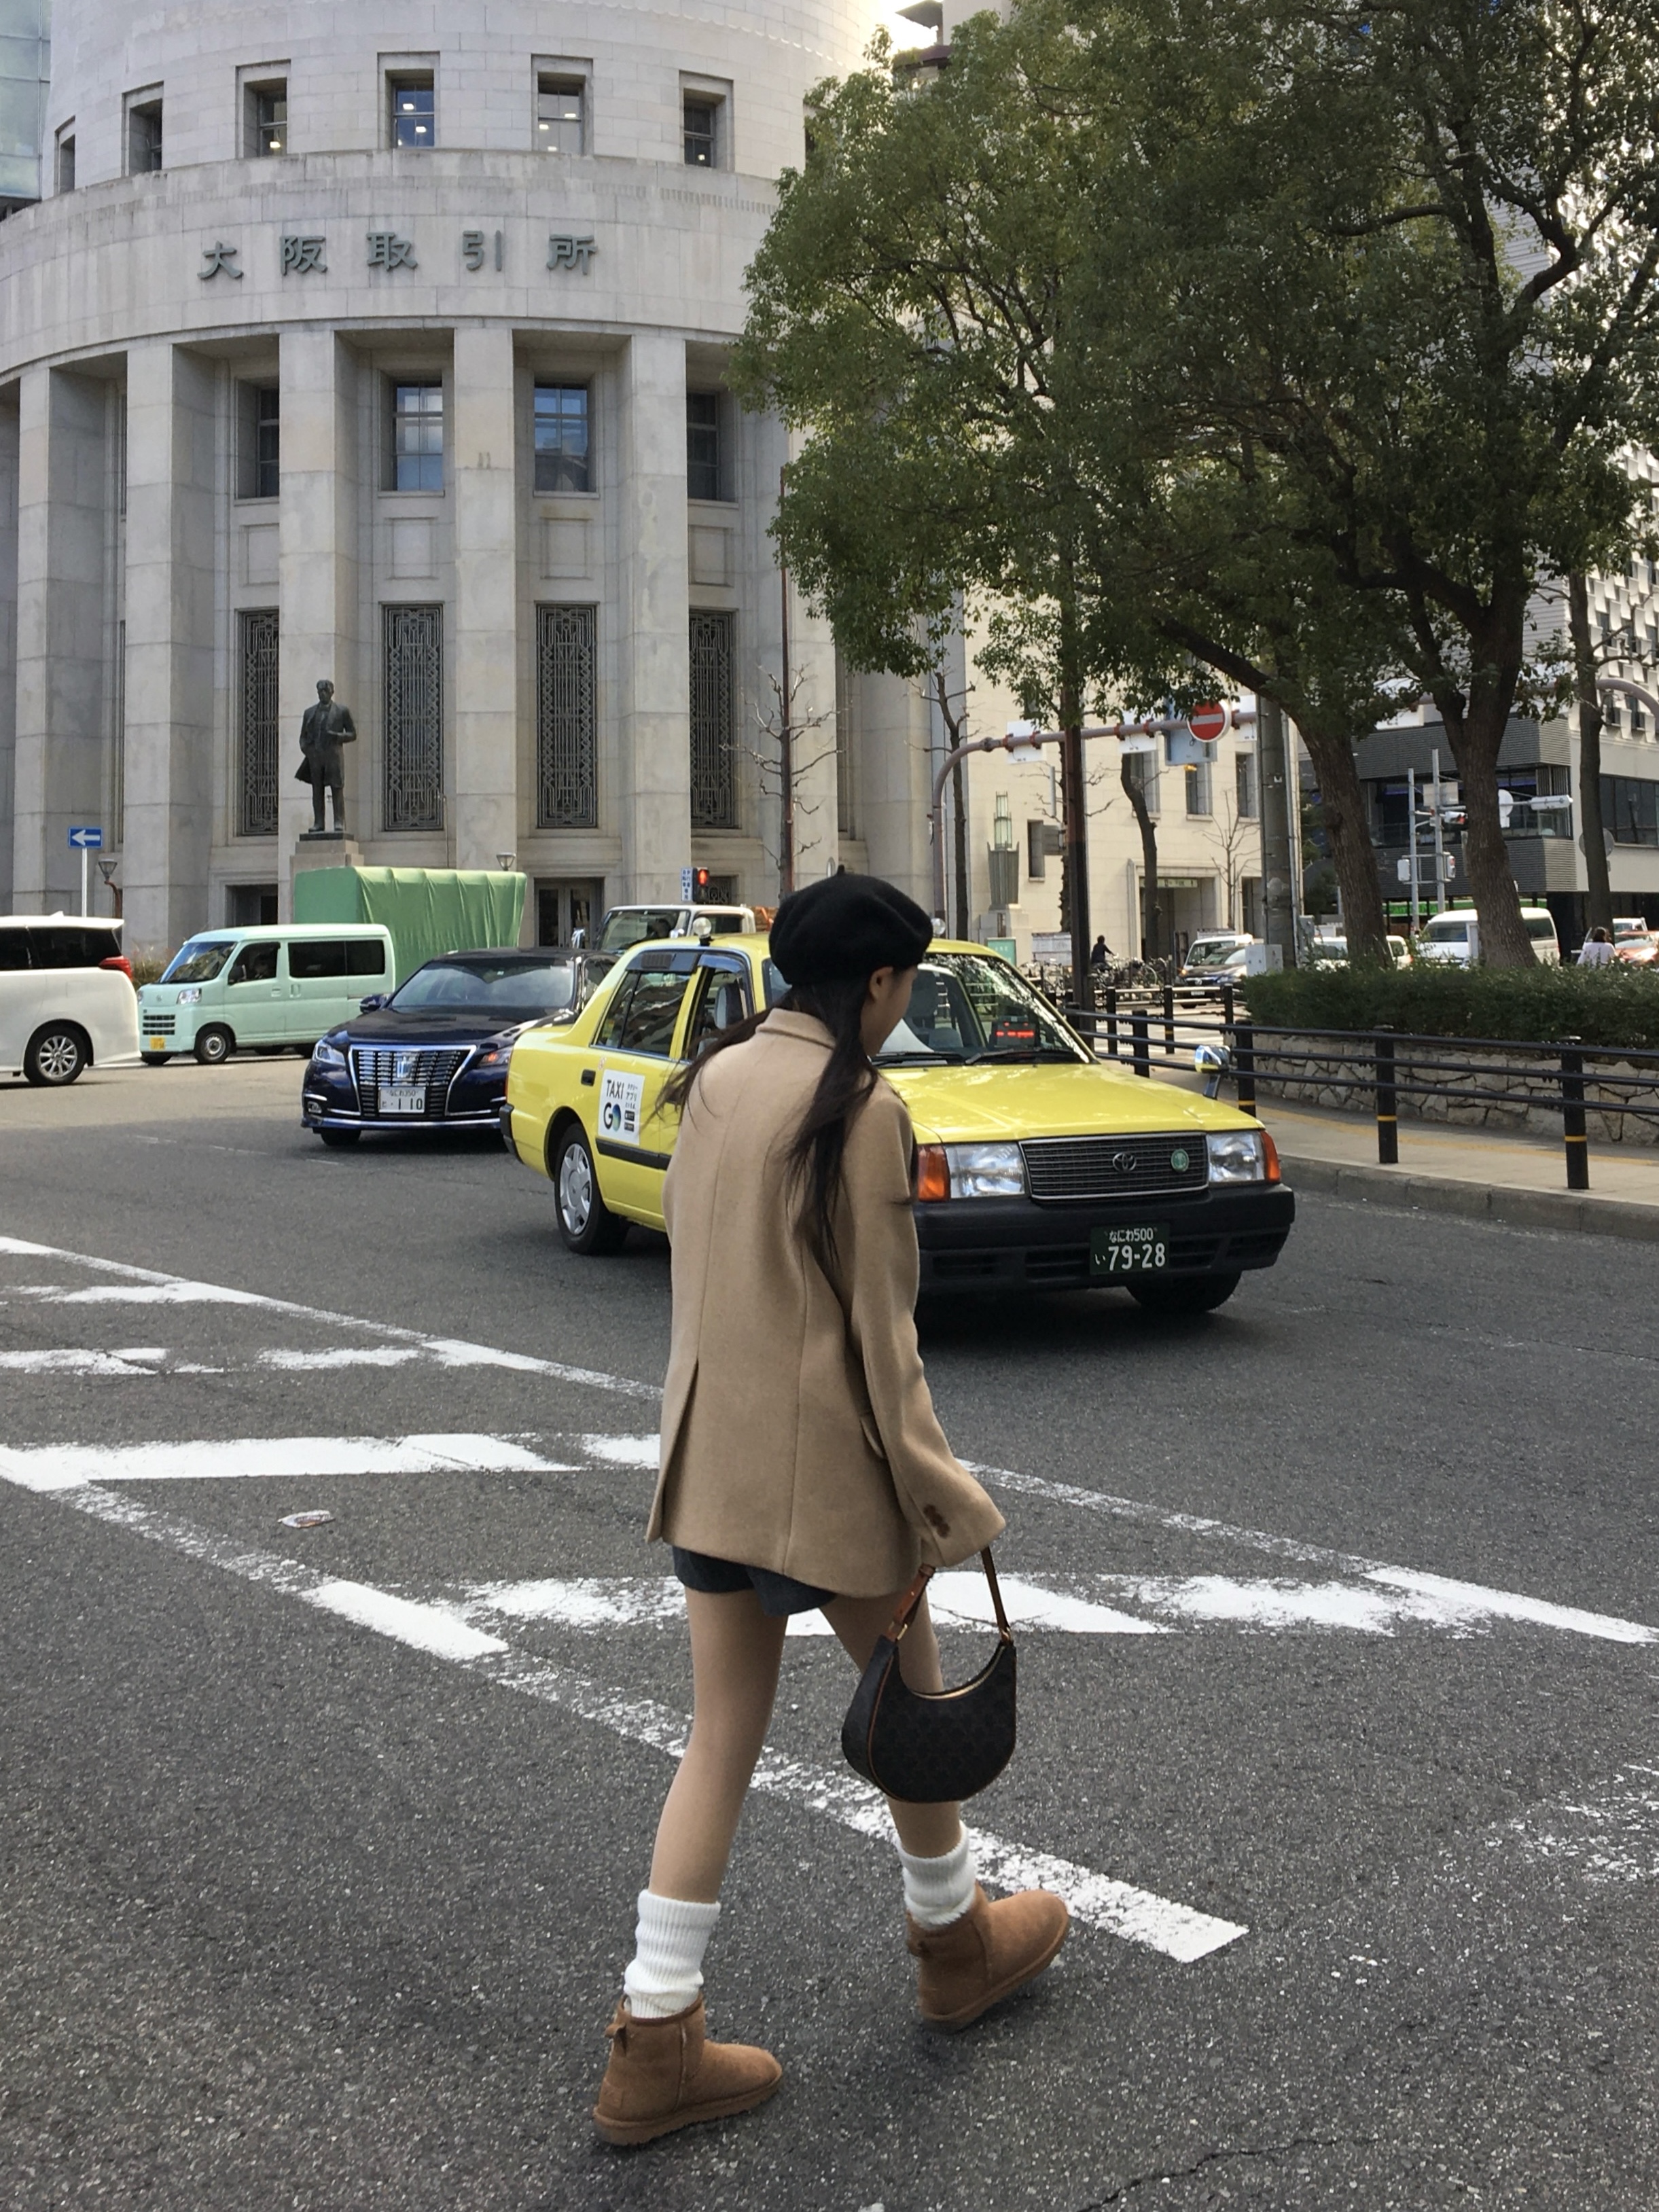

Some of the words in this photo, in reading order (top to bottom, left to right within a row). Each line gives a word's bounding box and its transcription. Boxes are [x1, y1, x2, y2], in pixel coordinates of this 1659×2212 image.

[197, 230, 598, 279] 大阪取引所
[606, 1079, 624, 1100] TAXI
[603, 1101, 621, 1132] GO
[1109, 1228, 1154, 1243] なにわ500
[1094, 1253, 1106, 1265] い
[1108, 1243, 1165, 1271] 79-28
